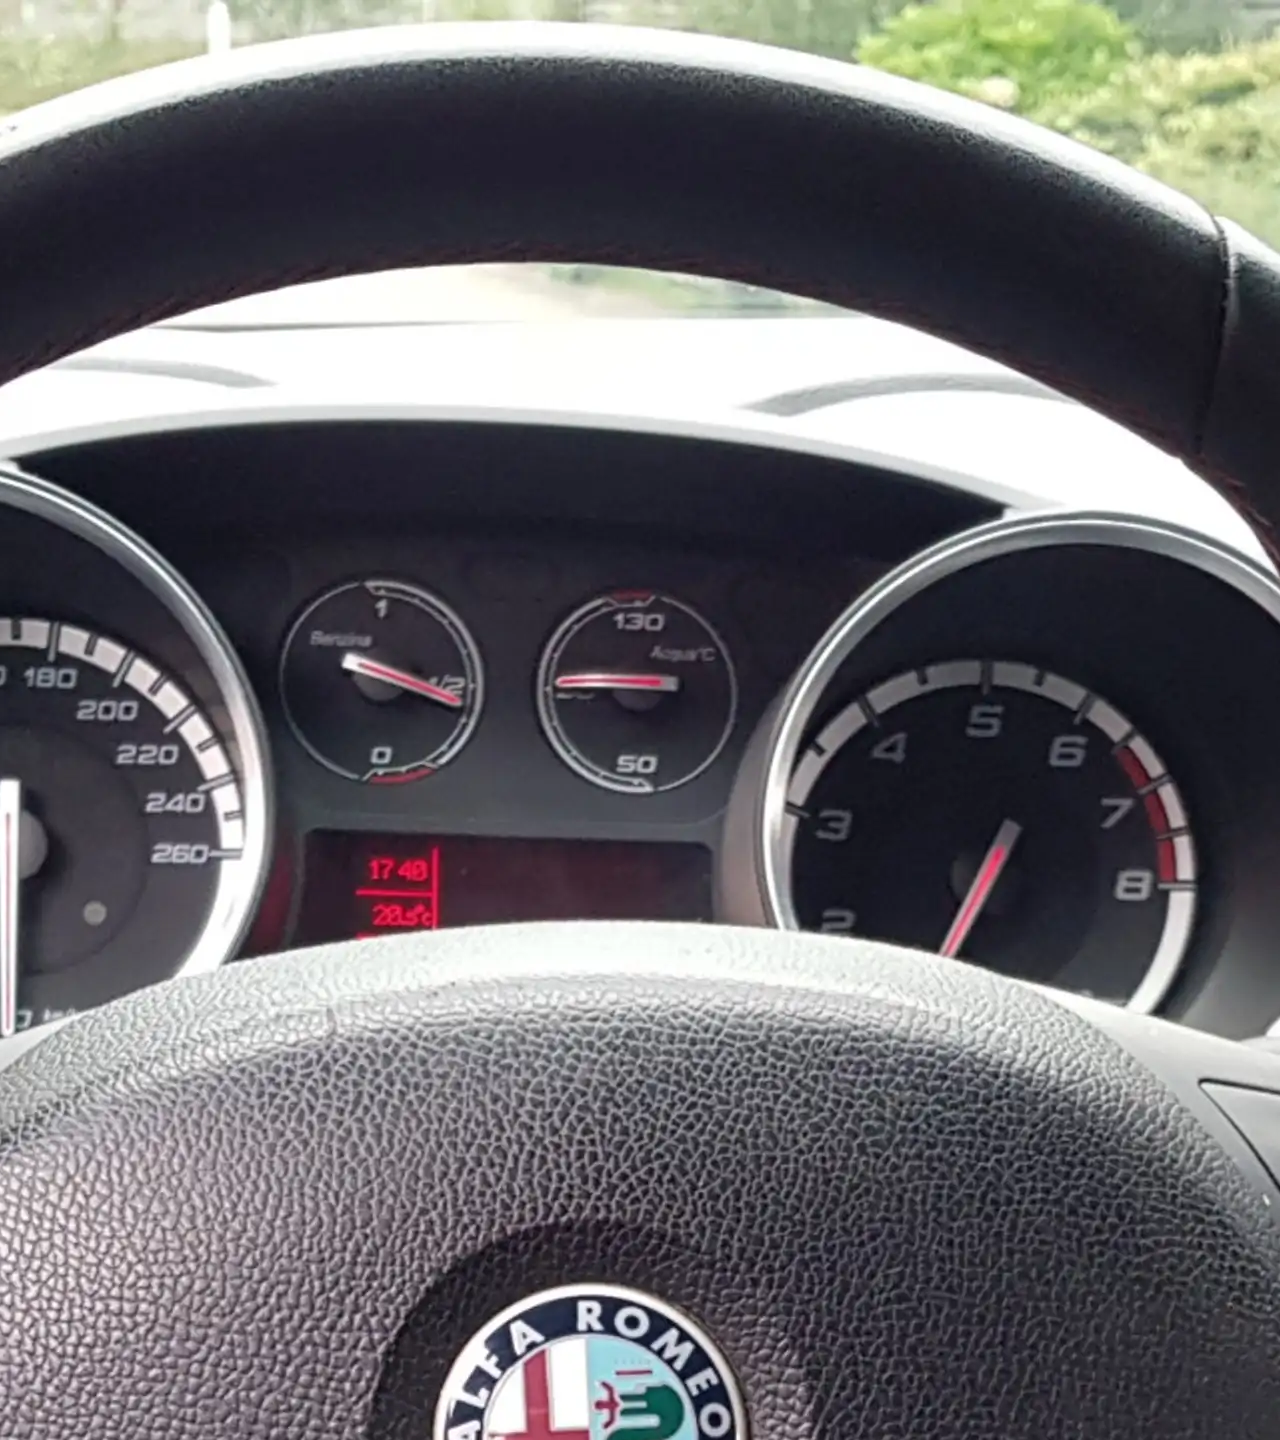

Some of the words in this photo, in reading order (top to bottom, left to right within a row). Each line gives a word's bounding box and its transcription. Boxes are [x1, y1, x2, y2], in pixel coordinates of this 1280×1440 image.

[374, 599, 388, 619] 1
[613, 613, 665, 632] 130
[23, 668, 78, 689] 180
[75, 700, 139, 721] 200
[965, 705, 1005, 738] 5
[115, 744, 179, 765] 220
[370, 746, 393, 764] 0
[871, 732, 908, 762] 4
[1048, 735, 1088, 768] 6
[616, 755, 659, 774] 50
[144, 793, 206, 813] 240
[1100, 797, 1134, 829] 7
[815, 809, 853, 841] 3
[150, 844, 208, 864] 260
[1114, 869, 1153, 901] 8
[819, 909, 856, 933] 2
[576, 1299, 732, 1440] ROMEO
